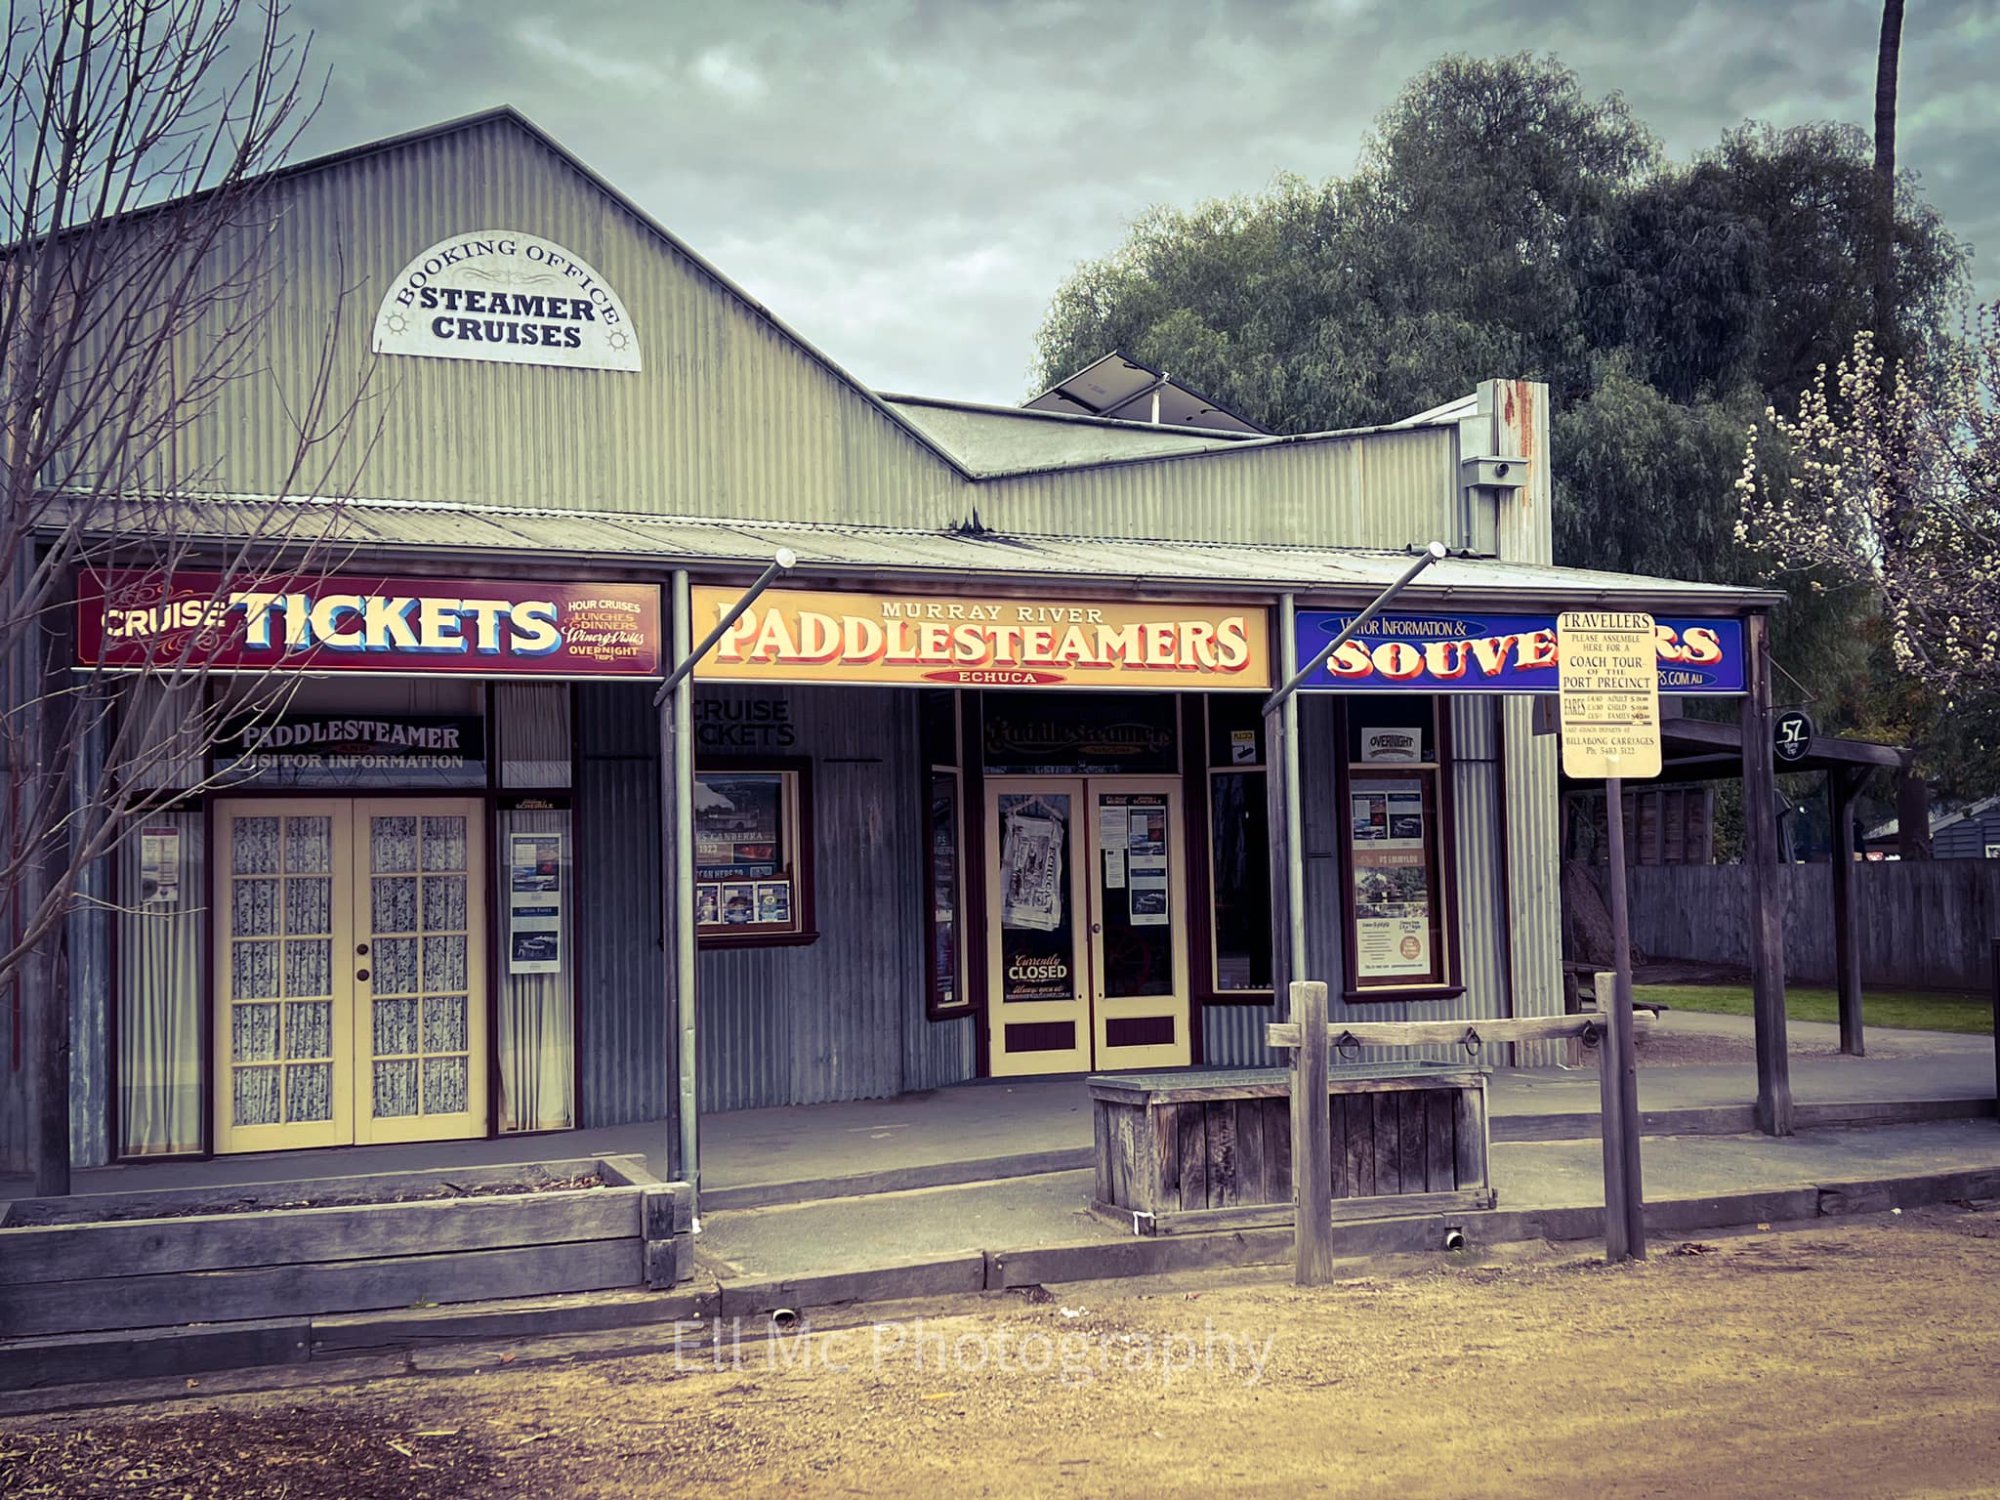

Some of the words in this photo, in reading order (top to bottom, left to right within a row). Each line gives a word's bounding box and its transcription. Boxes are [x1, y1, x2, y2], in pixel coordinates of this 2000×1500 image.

[396, 239, 517, 310] BOOKING
[525, 244, 621, 326] OFFICE
[420, 286, 596, 322] STEAMER
[432, 316, 582, 349] CRUISES
[568, 600, 597, 611] HOUR
[598, 600, 641, 613] CRUISES
[881, 602, 1002, 620] MURRAY
[1017, 605, 1103, 624] RIVER
[101, 599, 226, 637] CRUISE
[229, 592, 563, 656] TICKETS
[574, 612, 635, 622] LUNCHES
[1562, 613, 1650, 629] TRAVELLERS
[580, 621, 638, 631] DINNERS
[1340, 617, 1379, 636] VITOR
[1454, 619, 1467, 637] &
[714, 601, 1251, 674] PADDLESTEAMERS
[1571, 634, 1599, 643] PLEASE
[1603, 634, 1640, 643] ASSEMBLE
[569, 646, 639, 656] OVERNIGHT
[1327, 626, 1723, 681] SOUVERS
[1583, 643, 1602, 652] HERE
[1606, 643, 1620, 652] FOR
[1624, 644, 1630, 652] A
[1569, 656, 1607, 668] COACH
[1612, 656, 1642, 668] TOUR
[958, 671, 1037, 684] ECHUCA
[1563, 676, 1592, 688] PORT
[1598, 677, 1651, 689] PRECINCT
[1564, 698, 1586, 716] FARES
[243, 720, 460, 749] PADDLESTEAMER
[697, 723, 796, 746] CKETS
[1782, 720, 1803, 742] 57
[1370, 734, 1413, 748] OVERNIGHT
[1566, 737, 1608, 745] BILLABONG
[1610, 737, 1655, 746] CARRIAGES
[237, 754, 322, 769] VISITOR
[329, 755, 464, 770] INFORMATION
[709, 831, 763, 842] CANBERRA
[1014, 953, 1062, 967] Currently
[1008, 965, 1068, 980] CLOSED
